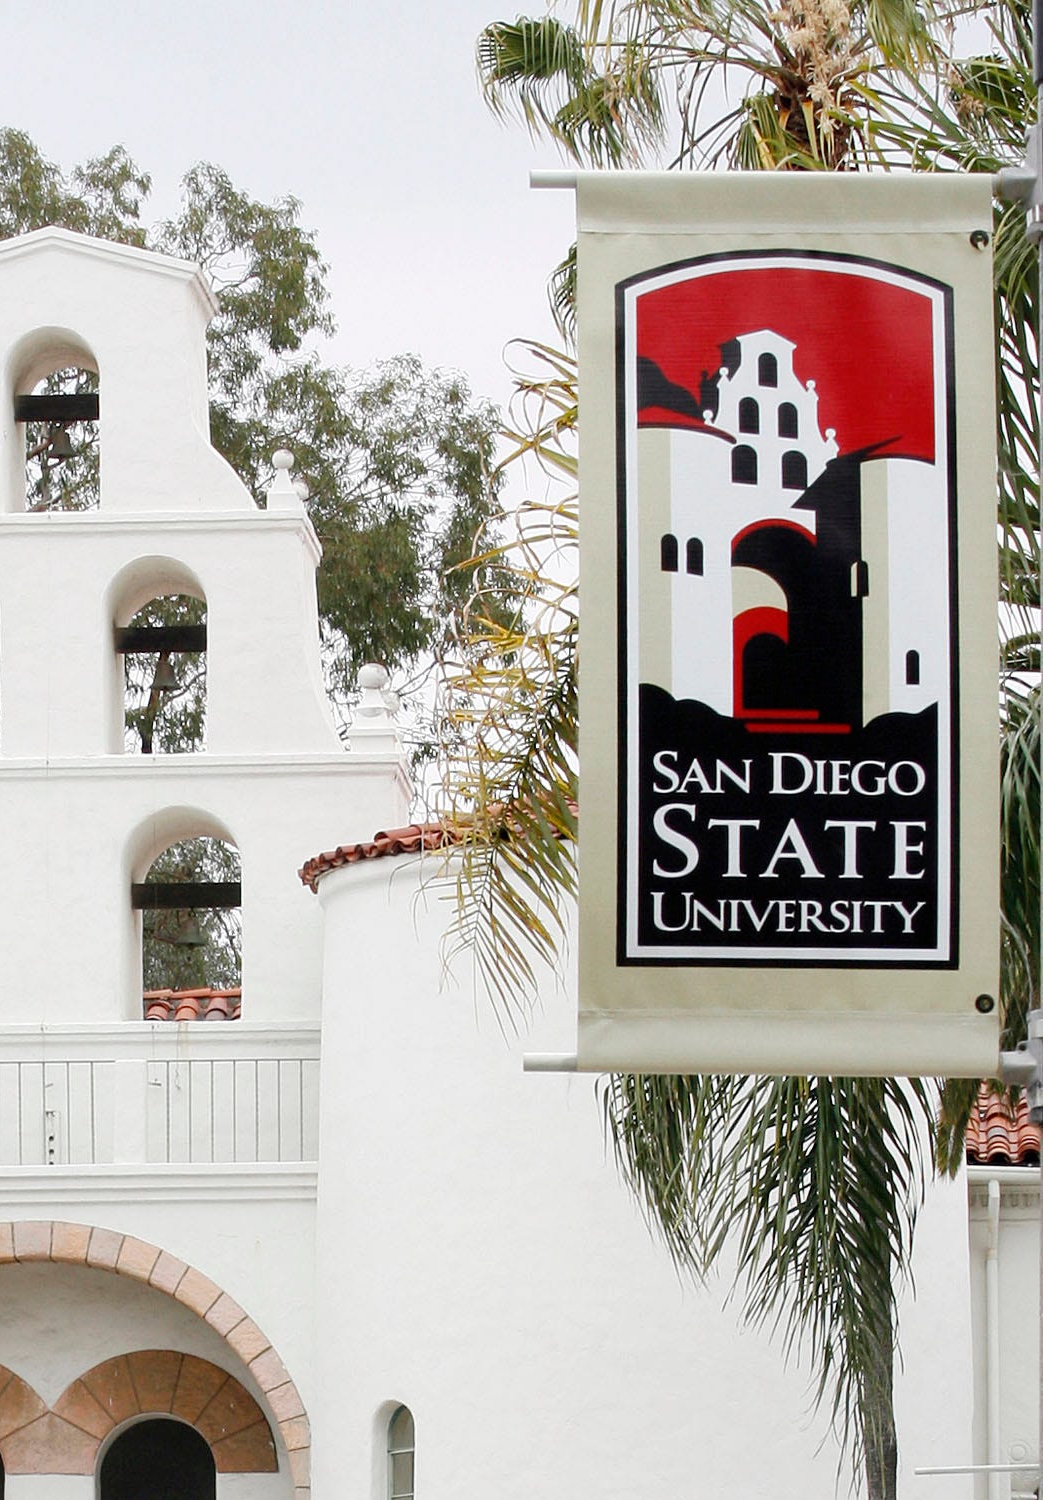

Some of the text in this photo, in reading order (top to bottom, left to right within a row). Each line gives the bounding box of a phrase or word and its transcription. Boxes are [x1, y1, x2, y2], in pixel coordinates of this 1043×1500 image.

[653, 751, 925, 795] SAN DIEGO
[653, 803, 926, 879] STATE
[651, 892, 925, 933] UNIVERSITY
